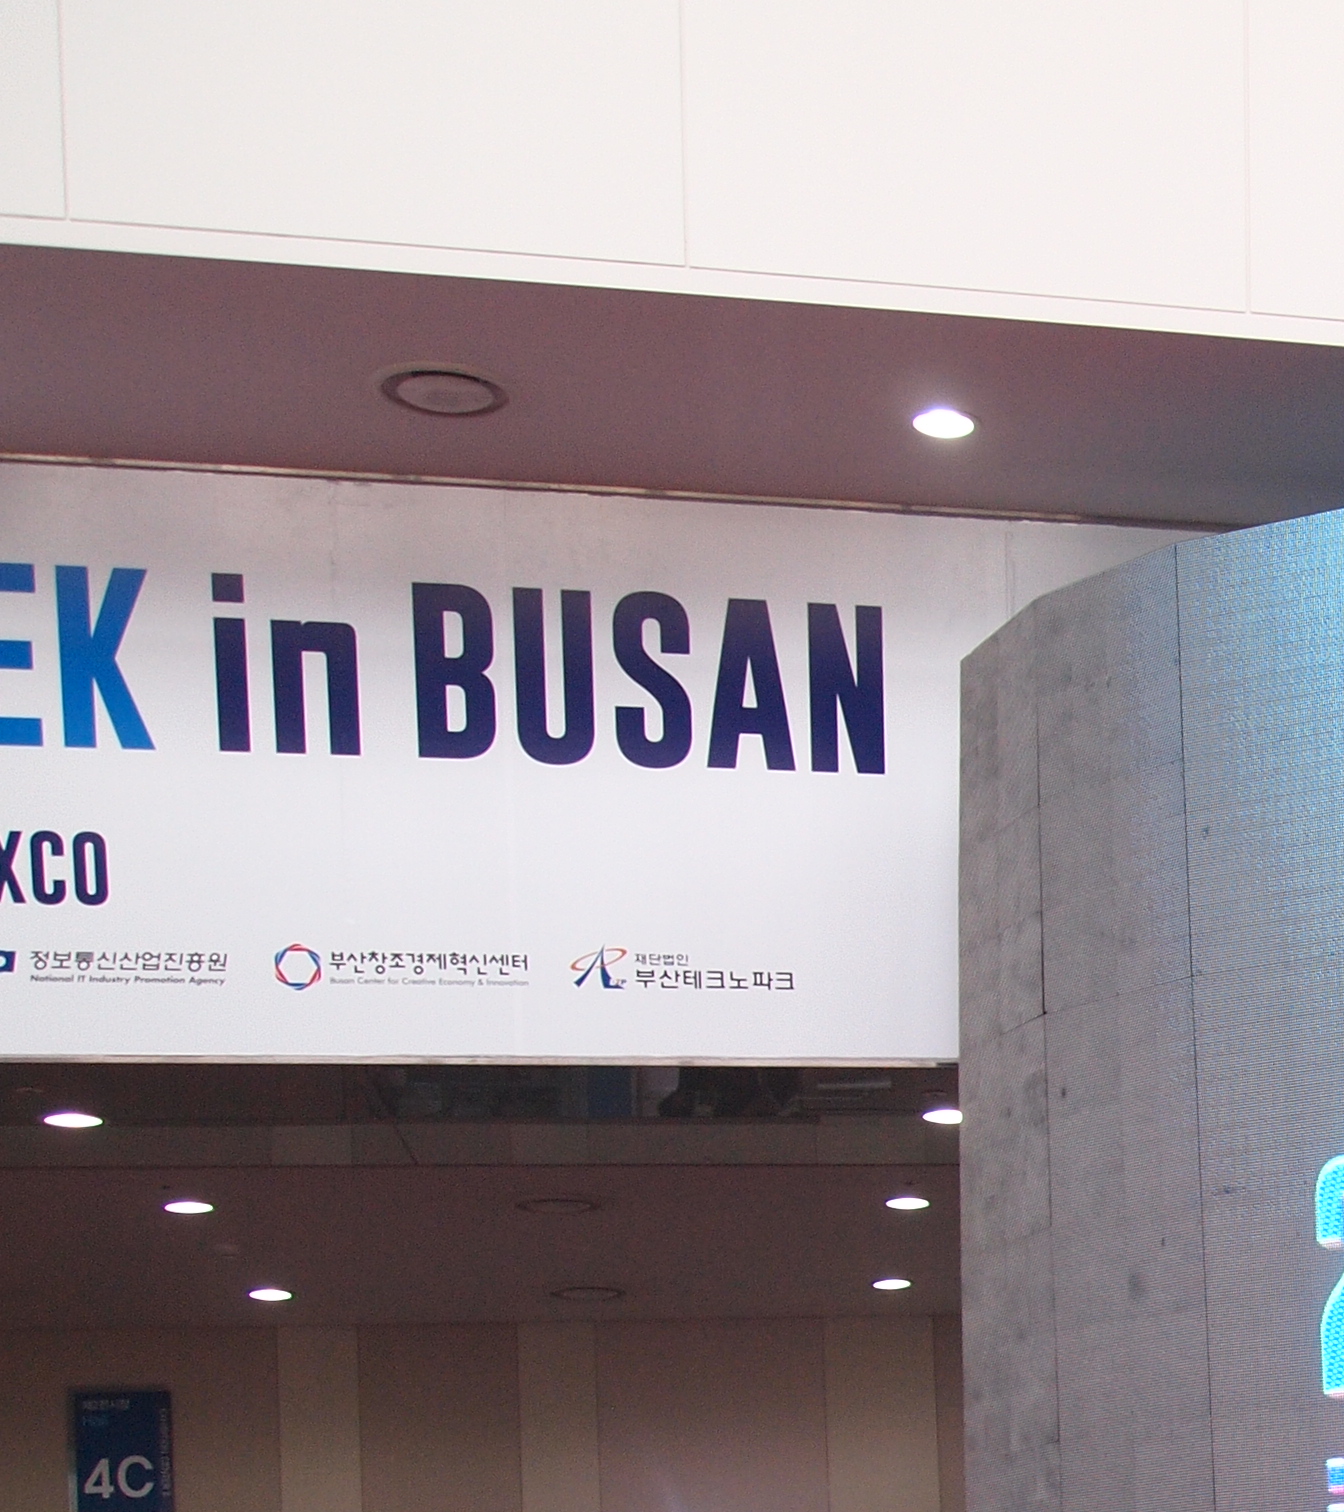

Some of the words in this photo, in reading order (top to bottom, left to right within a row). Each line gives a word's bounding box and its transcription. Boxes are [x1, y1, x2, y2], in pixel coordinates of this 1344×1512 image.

[212, 573, 362, 756] in
[411, 581, 887, 775] BUSAN
[30, 950, 227, 972] 정보통신산업진흥원
[329, 951, 529, 975] 부산창조경제혁신센터
[634, 953, 689, 966] 재단법인
[30, 974, 73, 983] National
[89, 975, 131, 986] Industry
[134, 976, 185, 985] Promotion
[189, 977, 226, 987] Agency
[635, 969, 795, 990] 부산테크노파크
[84, 1454, 155, 1499] 4C
